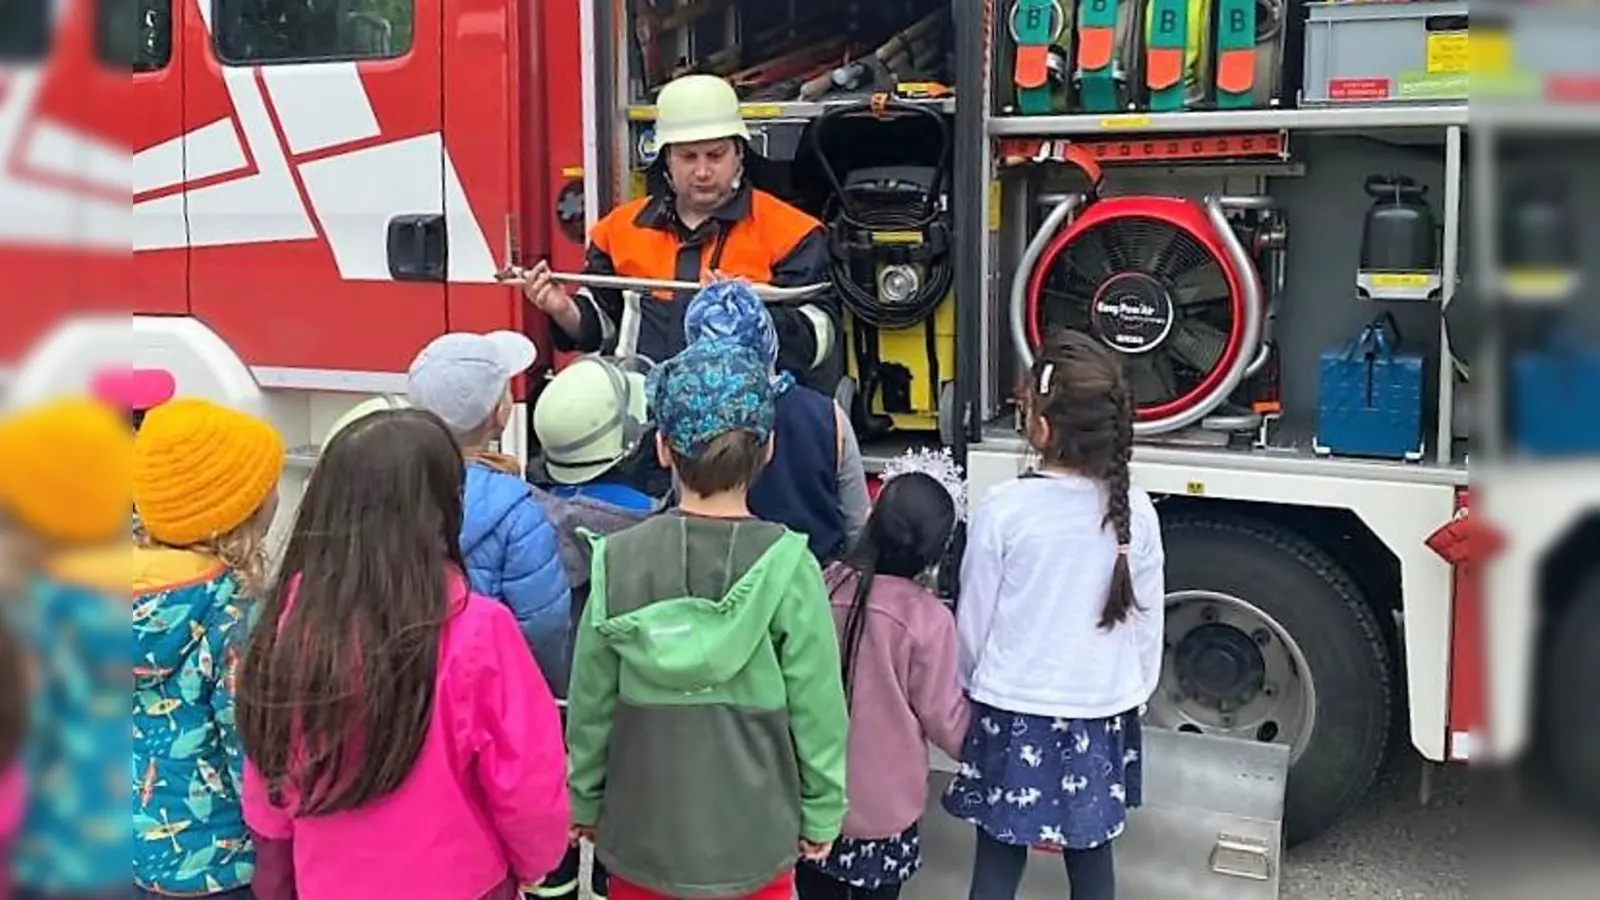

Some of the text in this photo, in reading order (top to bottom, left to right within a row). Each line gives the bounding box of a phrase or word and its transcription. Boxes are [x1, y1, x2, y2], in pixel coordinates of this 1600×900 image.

[1027, 8, 1041, 30] B
[1161, 9, 1176, 33] B
[1230, 8, 1246, 33] B
